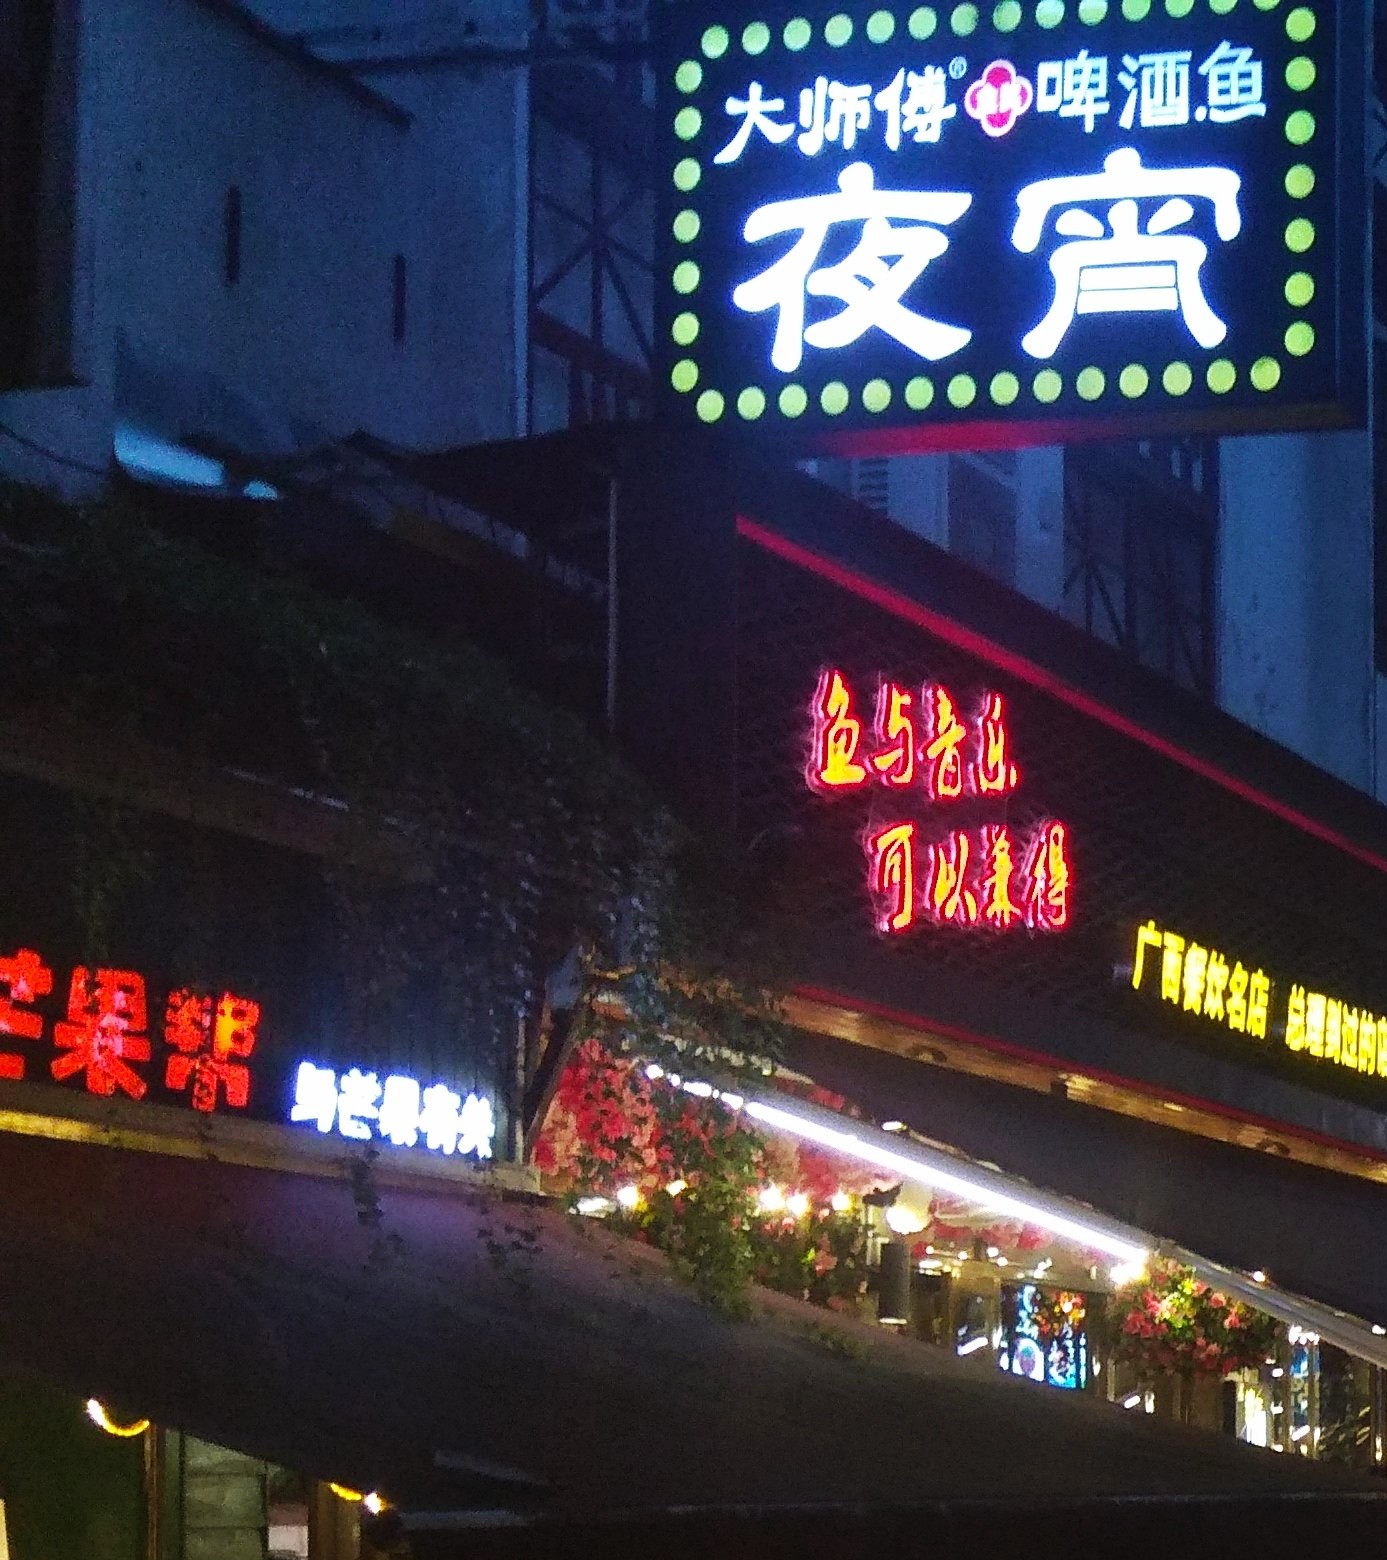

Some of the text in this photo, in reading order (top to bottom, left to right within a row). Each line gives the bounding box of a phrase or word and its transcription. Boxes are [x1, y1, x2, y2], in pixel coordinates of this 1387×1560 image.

[712, 65, 958, 165] 大师傅
[1036, 40, 1268, 133] 啤酒鱼
[732, 147, 1243, 374] 夜宵
[1131, 919, 1271, 1041] 广西餐饮名店
